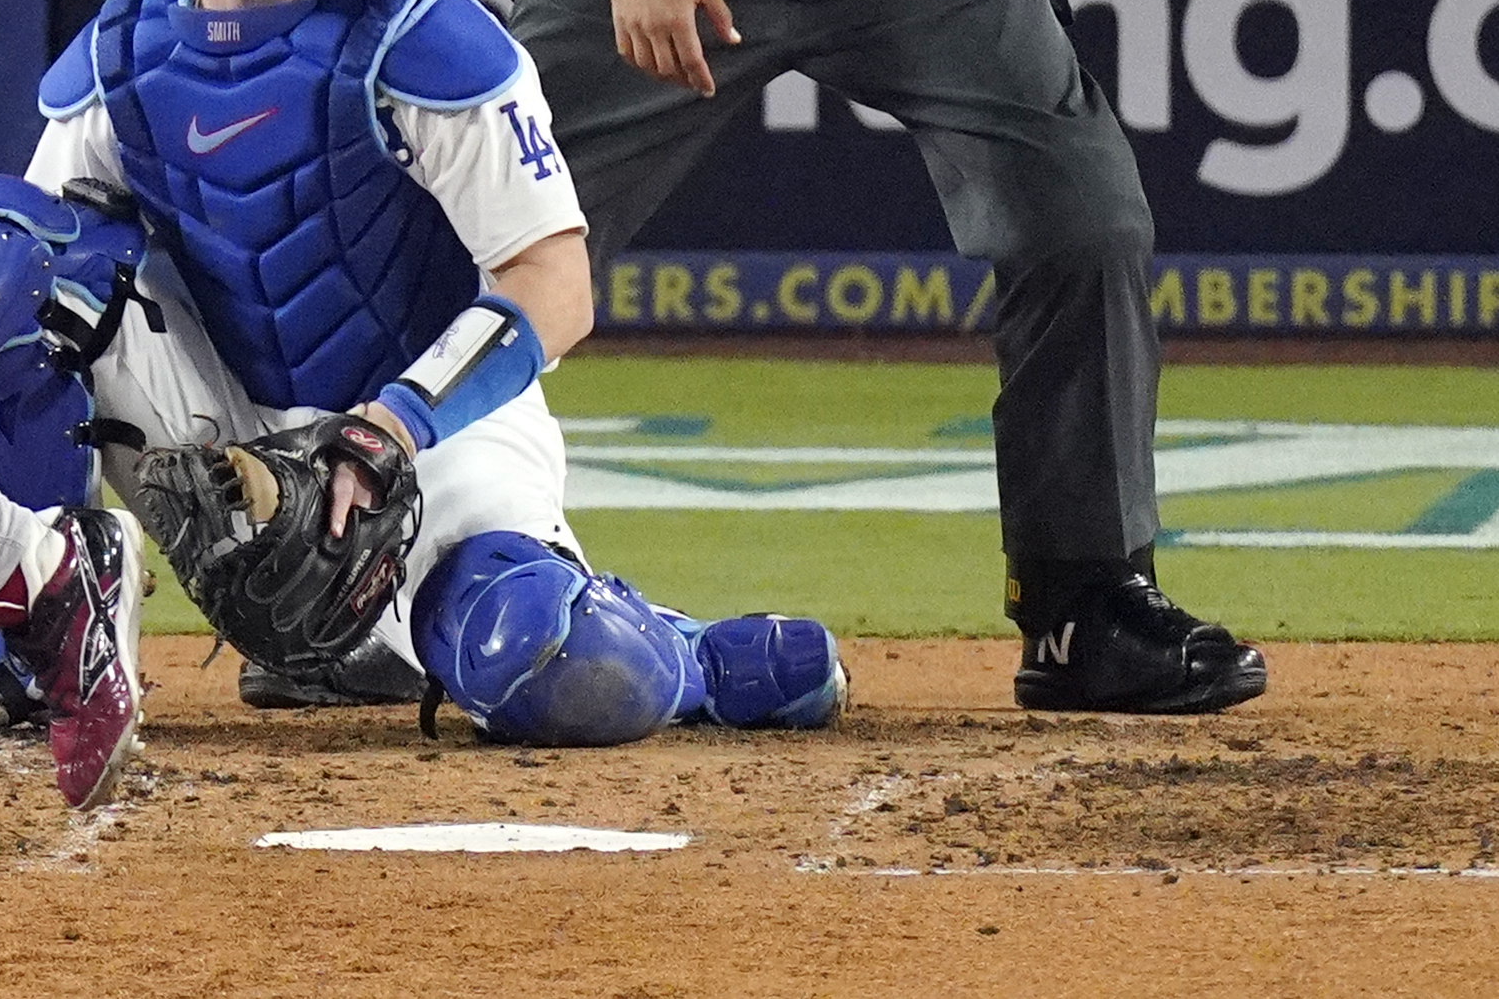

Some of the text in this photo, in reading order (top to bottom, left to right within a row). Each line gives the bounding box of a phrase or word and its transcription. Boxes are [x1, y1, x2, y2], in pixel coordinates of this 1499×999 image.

[207, 21, 240, 42] SMITH
[499, 100, 562, 181] LA
[1037, 621, 1076, 665] N
